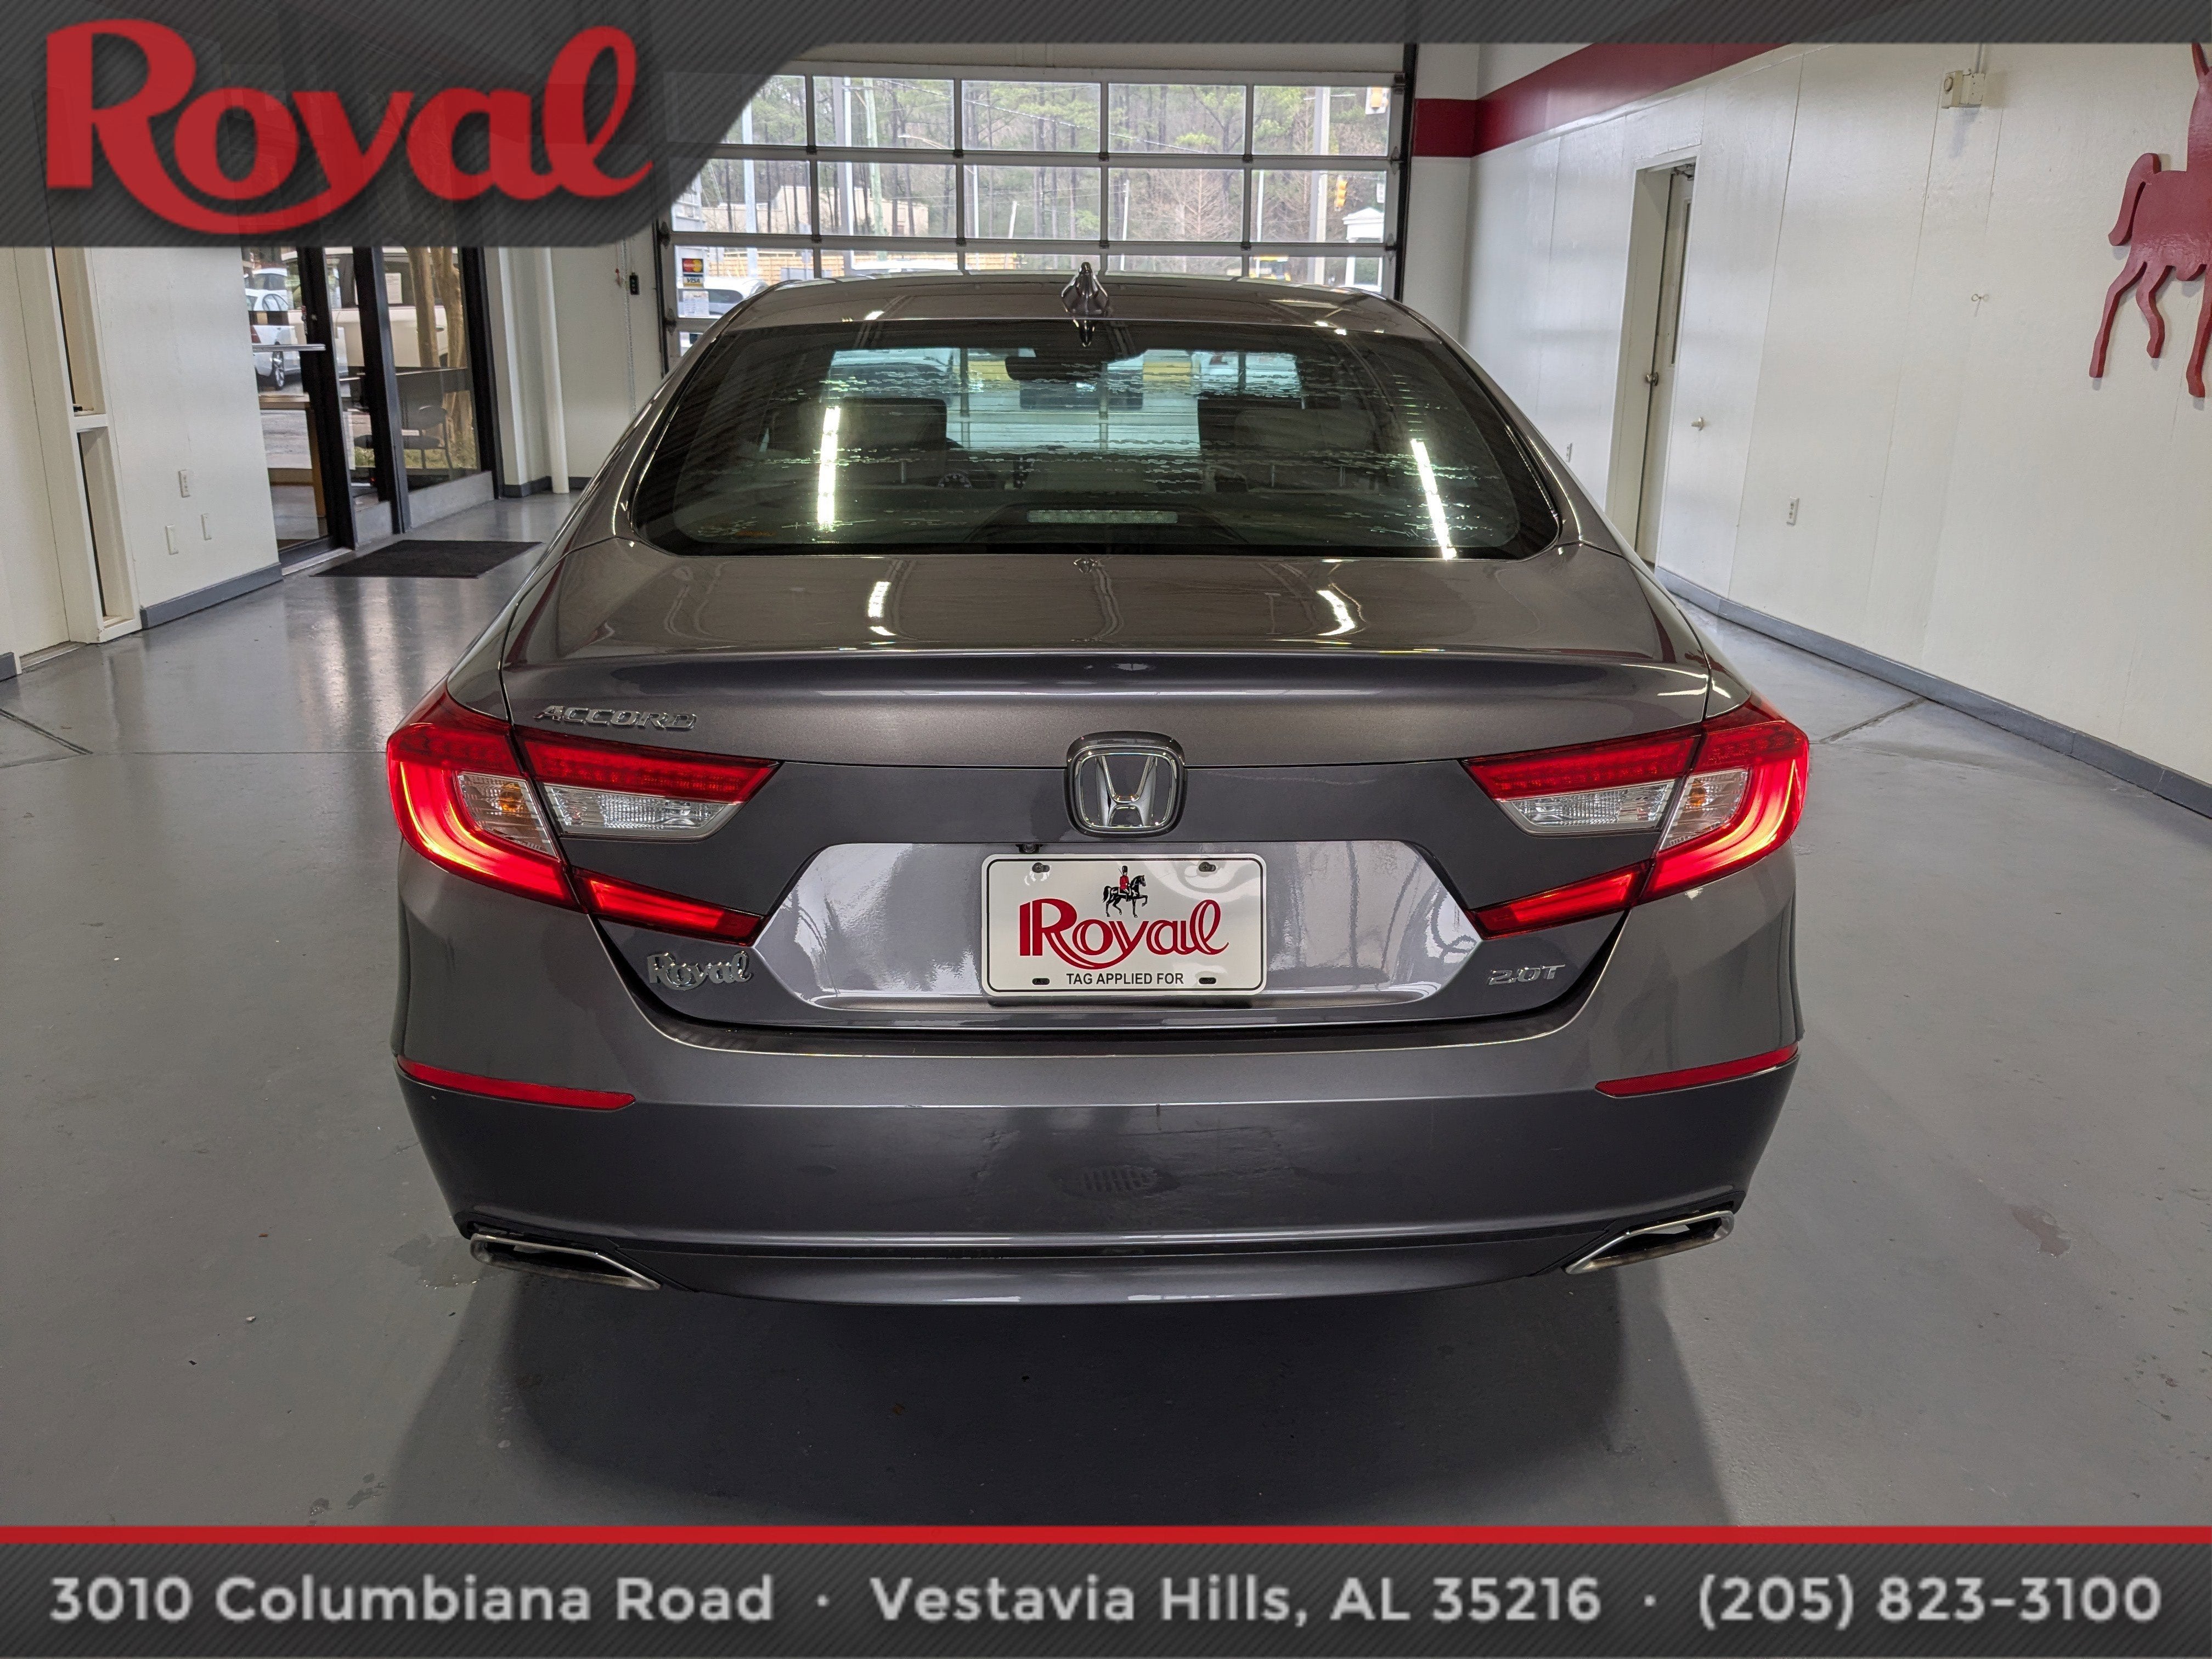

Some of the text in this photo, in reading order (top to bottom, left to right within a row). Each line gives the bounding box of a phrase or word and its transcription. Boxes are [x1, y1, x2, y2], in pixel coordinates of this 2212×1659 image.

[533, 706, 697, 731] ACCORD
[1019, 898, 1229, 970] Royal
[647, 951, 754, 991] Royal
[1066, 973, 1184, 985] TAG APPLIED FOR
